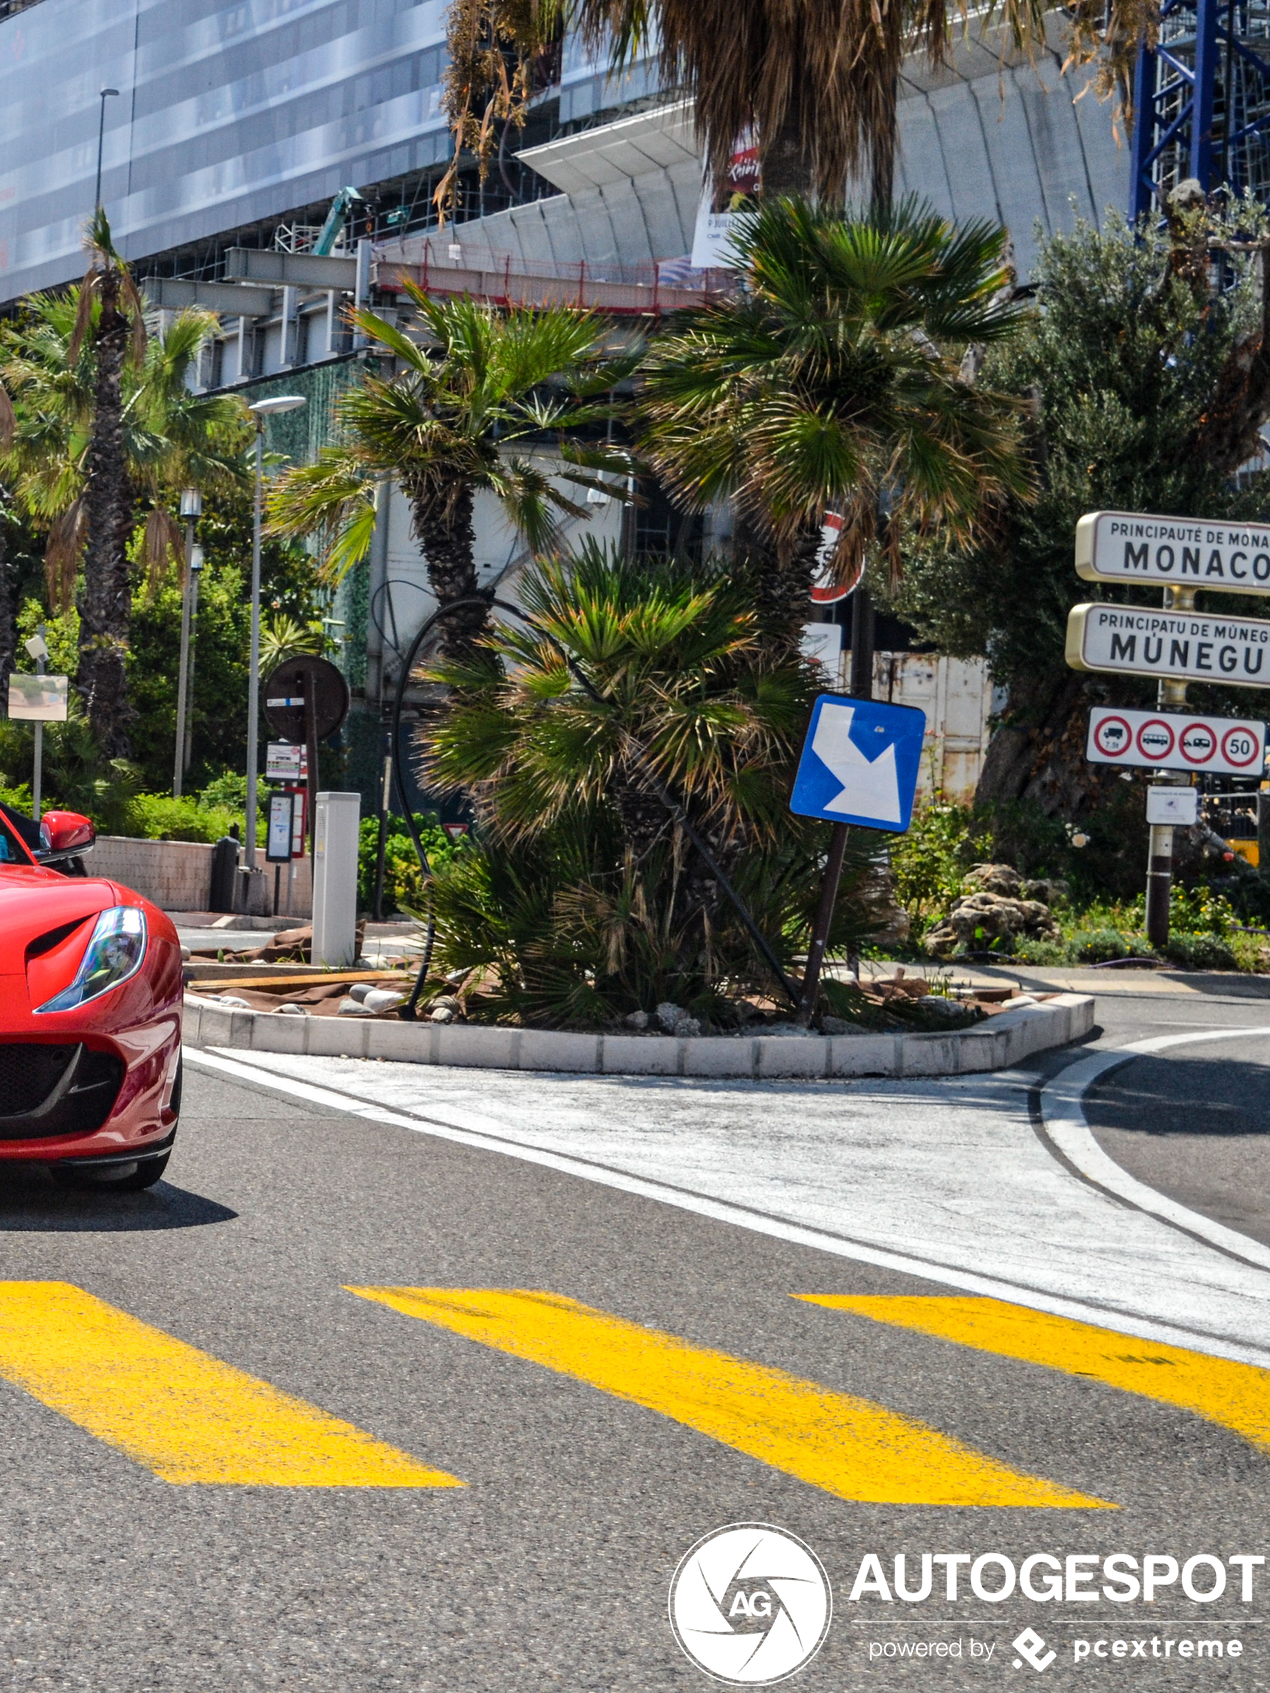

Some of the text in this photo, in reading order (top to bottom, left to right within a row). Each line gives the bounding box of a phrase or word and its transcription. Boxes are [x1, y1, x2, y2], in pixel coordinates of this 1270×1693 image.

[1110, 522, 1270, 549] PRINCIPAUTÉ DE MONA
[1123, 541, 1270, 581] MONACO
[1098, 613, 1186, 635] PRINCIPATU
[1190, 623, 1210, 637] DE
[1229, 739, 1250, 755] 50
